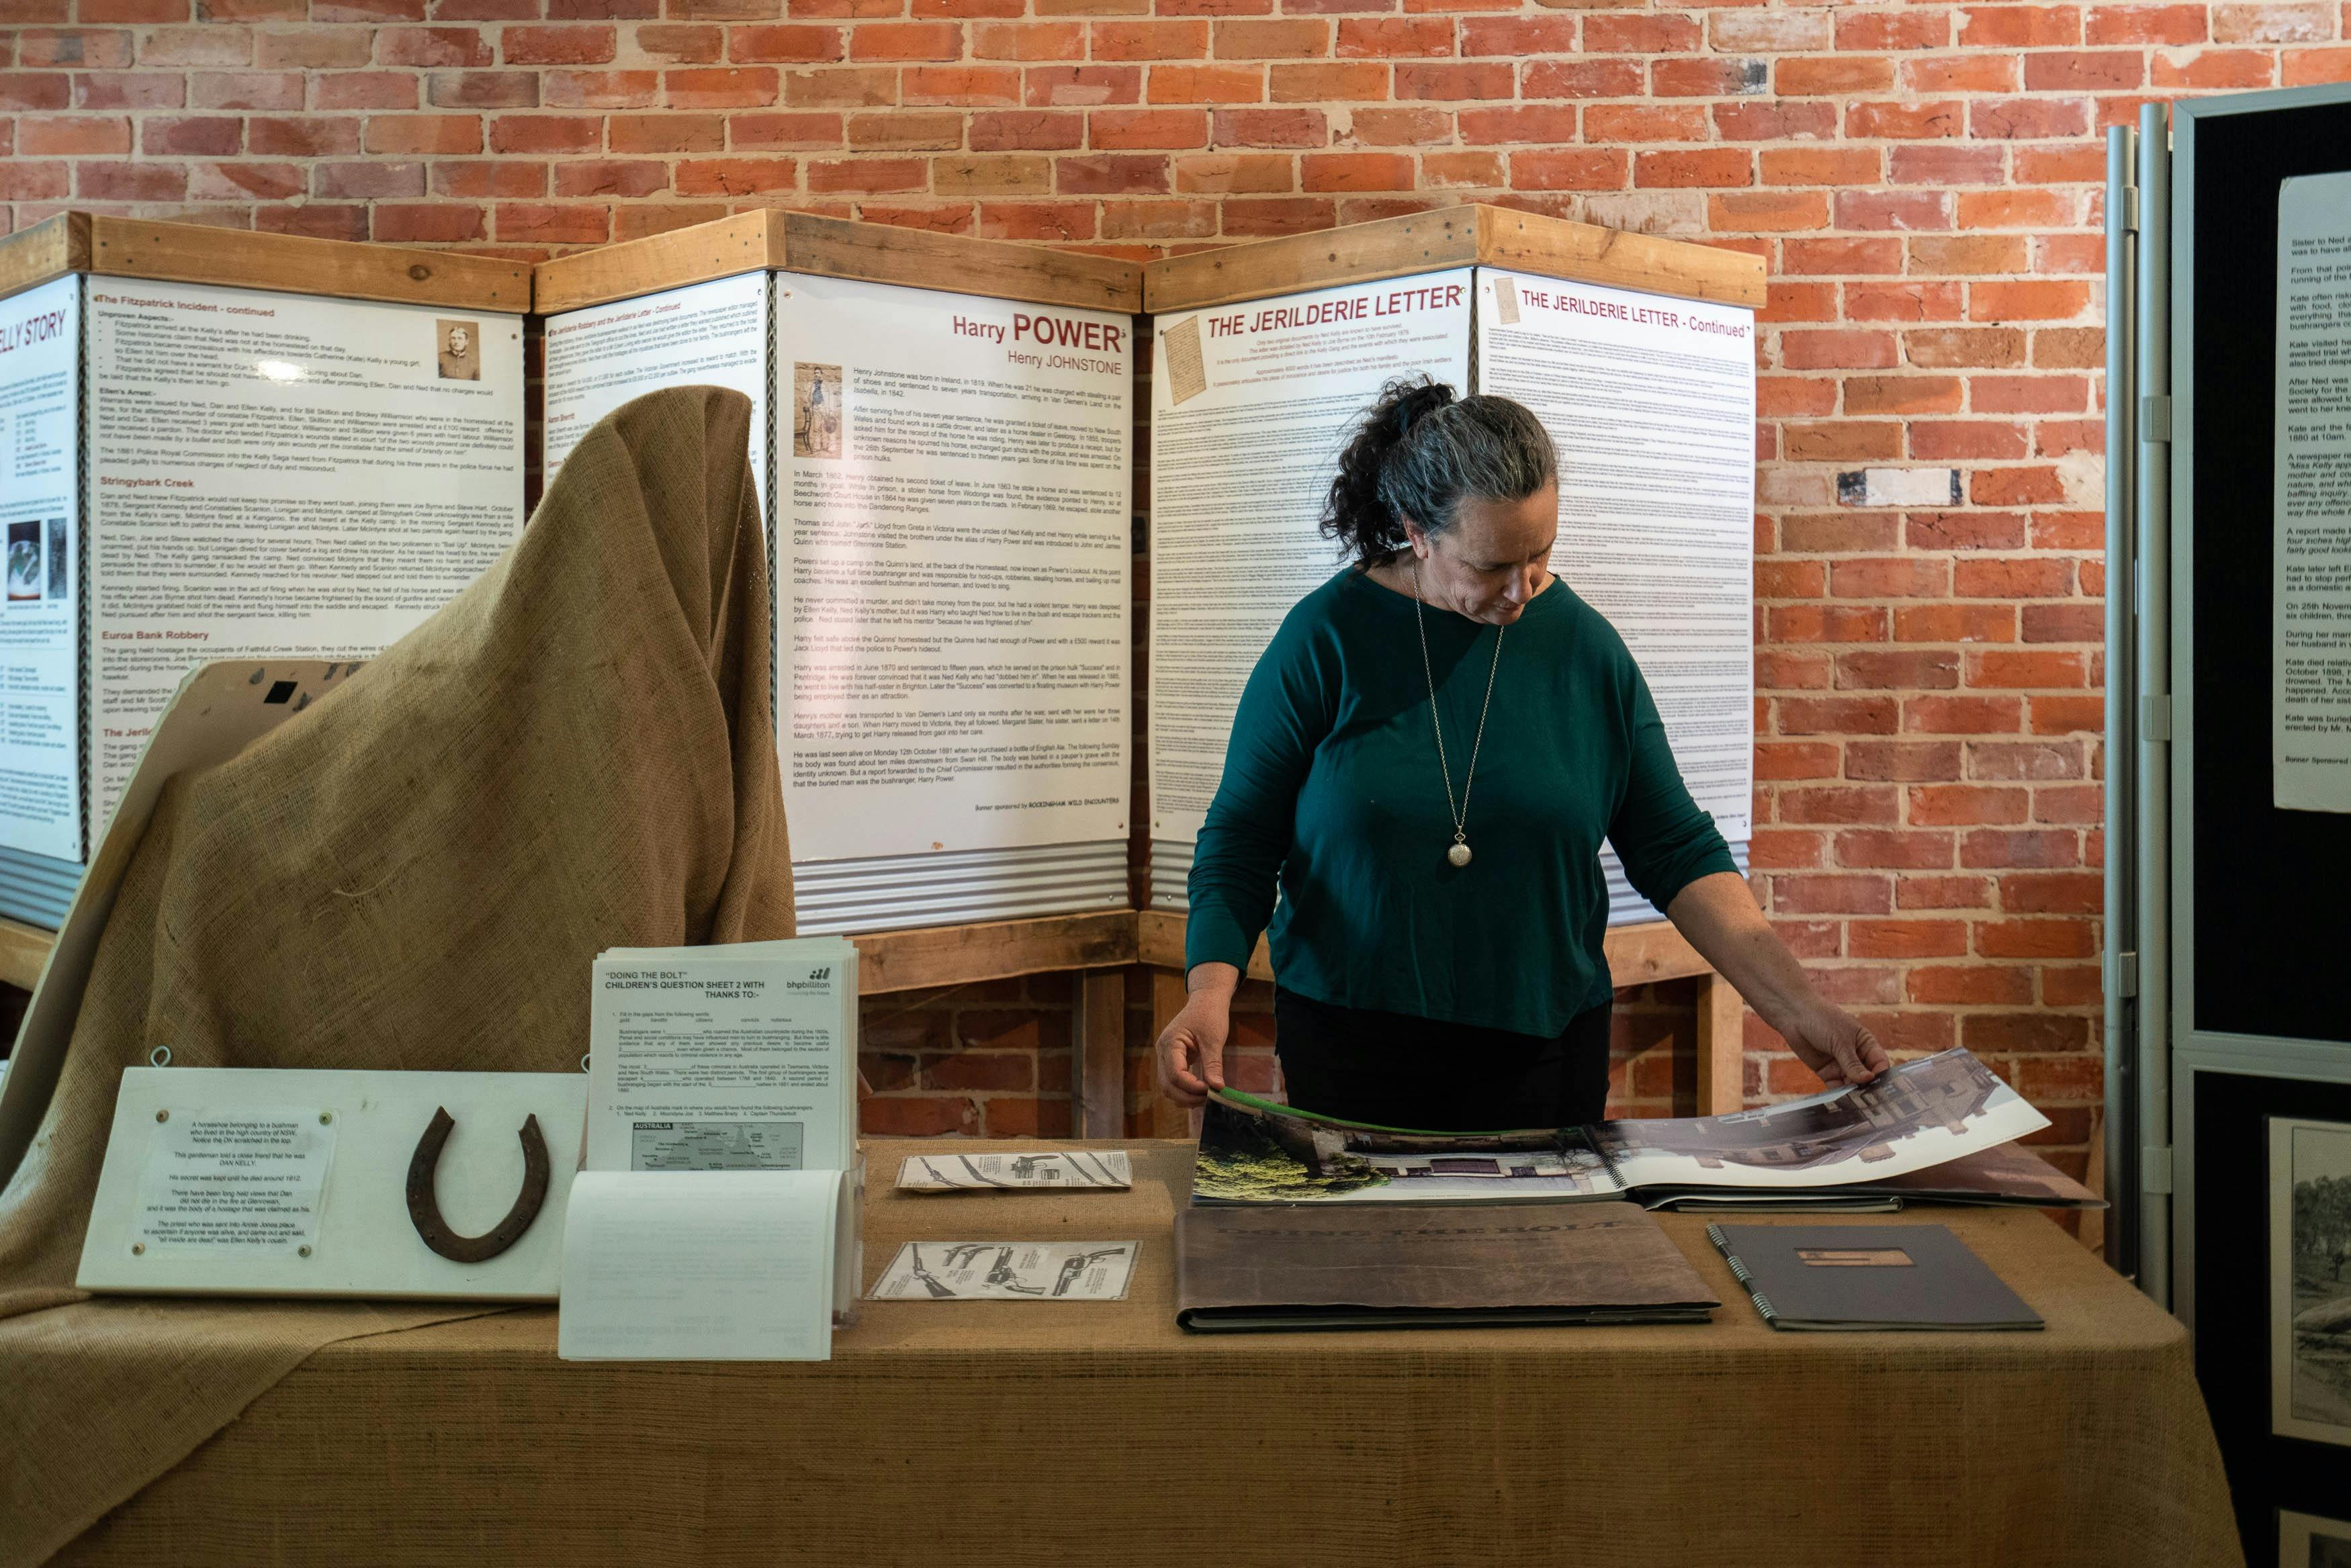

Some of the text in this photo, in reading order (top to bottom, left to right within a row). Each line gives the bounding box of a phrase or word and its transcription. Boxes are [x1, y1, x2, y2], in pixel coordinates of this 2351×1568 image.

[2292, 236, 2344, 247] Sister to Ned
[2310, 246, 2317, 255] to
[2320, 246, 2340, 254] have
[2291, 264, 2332, 275] From that
[2291, 273, 2346, 284] running of the
[2311, 293, 2332, 301] often
[97, 293, 117, 304] The
[120, 295, 174, 308] Fitzpatrick
[177, 301, 217, 312] Incident
[226, 306, 274, 317] continued
[2290, 303, 2306, 312] with
[97, 310, 136, 318] Unproven
[1208, 285, 1460, 338] THE JERILDERIE LETTER
[1522, 289, 1548, 308] THE
[1553, 295, 1628, 320] JERILDERIE
[1632, 307, 1678, 328] LETTER
[1689, 316, 1744, 337] Continued
[2289, 311, 2332, 322] everything
[25, 308, 66, 345] STORY
[953, 315, 1005, 344] Harry
[2289, 319, 2341, 330] bushrangers
[1014, 313, 1122, 353] POWER
[2289, 338, 2338, 349] Kate visited
[1008, 349, 1122, 375] Henry JOHNSTONE
[853, 367, 872, 376] Henry
[873, 369, 905, 379] Johnstone
[1053, 388, 1074, 396] charged
[2289, 377, 2348, 386] After Ned was
[99, 387, 125, 395] Ellen's
[2289, 385, 2348, 396] Society for the
[2288, 405, 2334, 414] went to her
[2310, 424, 2325, 432] and
[2289, 433, 2308, 442] 1880
[2311, 433, 2318, 441] at
[100, 476, 193, 488] Stringybark Creek
[101, 631, 208, 641] Euroa Bank Robbery
[103, 728, 122, 737] The
[994, 803, 1020, 811] sponsored
[1028, 800, 1065, 808] ROCKINGHAM
[1083, 797, 1119, 805] ENCOUNTERS
[641, 971, 657, 979] THE
[660, 971, 686, 979] BOLT"
[660, 980, 703, 988] QUESTION
[706, 980, 734, 988] SHEET
[787, 980, 830, 990] bhpbilliton
[197, 1121, 228, 1129] horseshoe
[229, 1121, 258, 1129] belonging
[225, 1129, 234, 1137] the
[236, 1129, 249, 1137] high
[263, 1136, 269, 1144] in
[174, 1151, 187, 1160] This
[187, 1152, 218, 1160] gentleman
[220, 1152, 230, 1160] told
[231, 1152, 236, 1160] a
[236, 1152, 253, 1160] close
[254, 1152, 271, 1160] friend
[271, 1152, 283, 1160] that
[1497, 1219, 1621, 1233] BOLT
